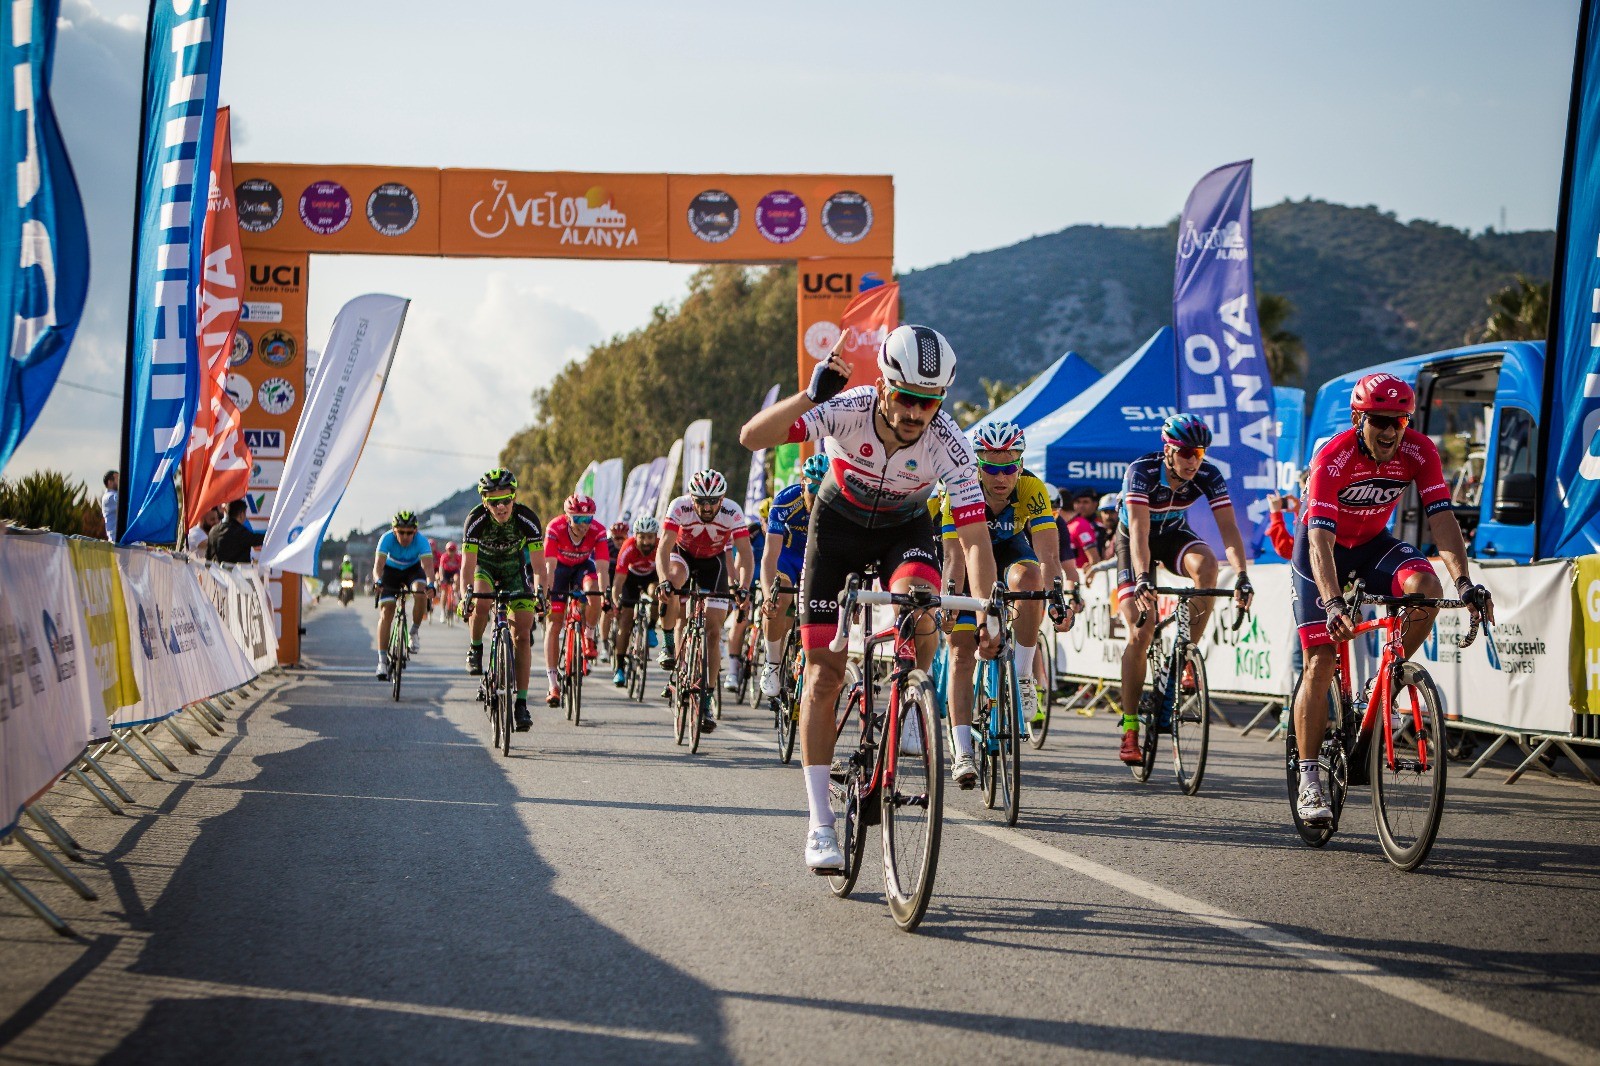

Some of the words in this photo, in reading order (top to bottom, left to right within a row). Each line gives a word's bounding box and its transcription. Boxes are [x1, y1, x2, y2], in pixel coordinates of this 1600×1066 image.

[560, 227, 638, 248] ALANYA
[250, 265, 300, 286] UCI
[803, 273, 853, 293] UCI
[1402, 441, 1421, 451] BANK
[903, 550, 933, 560] HOME
